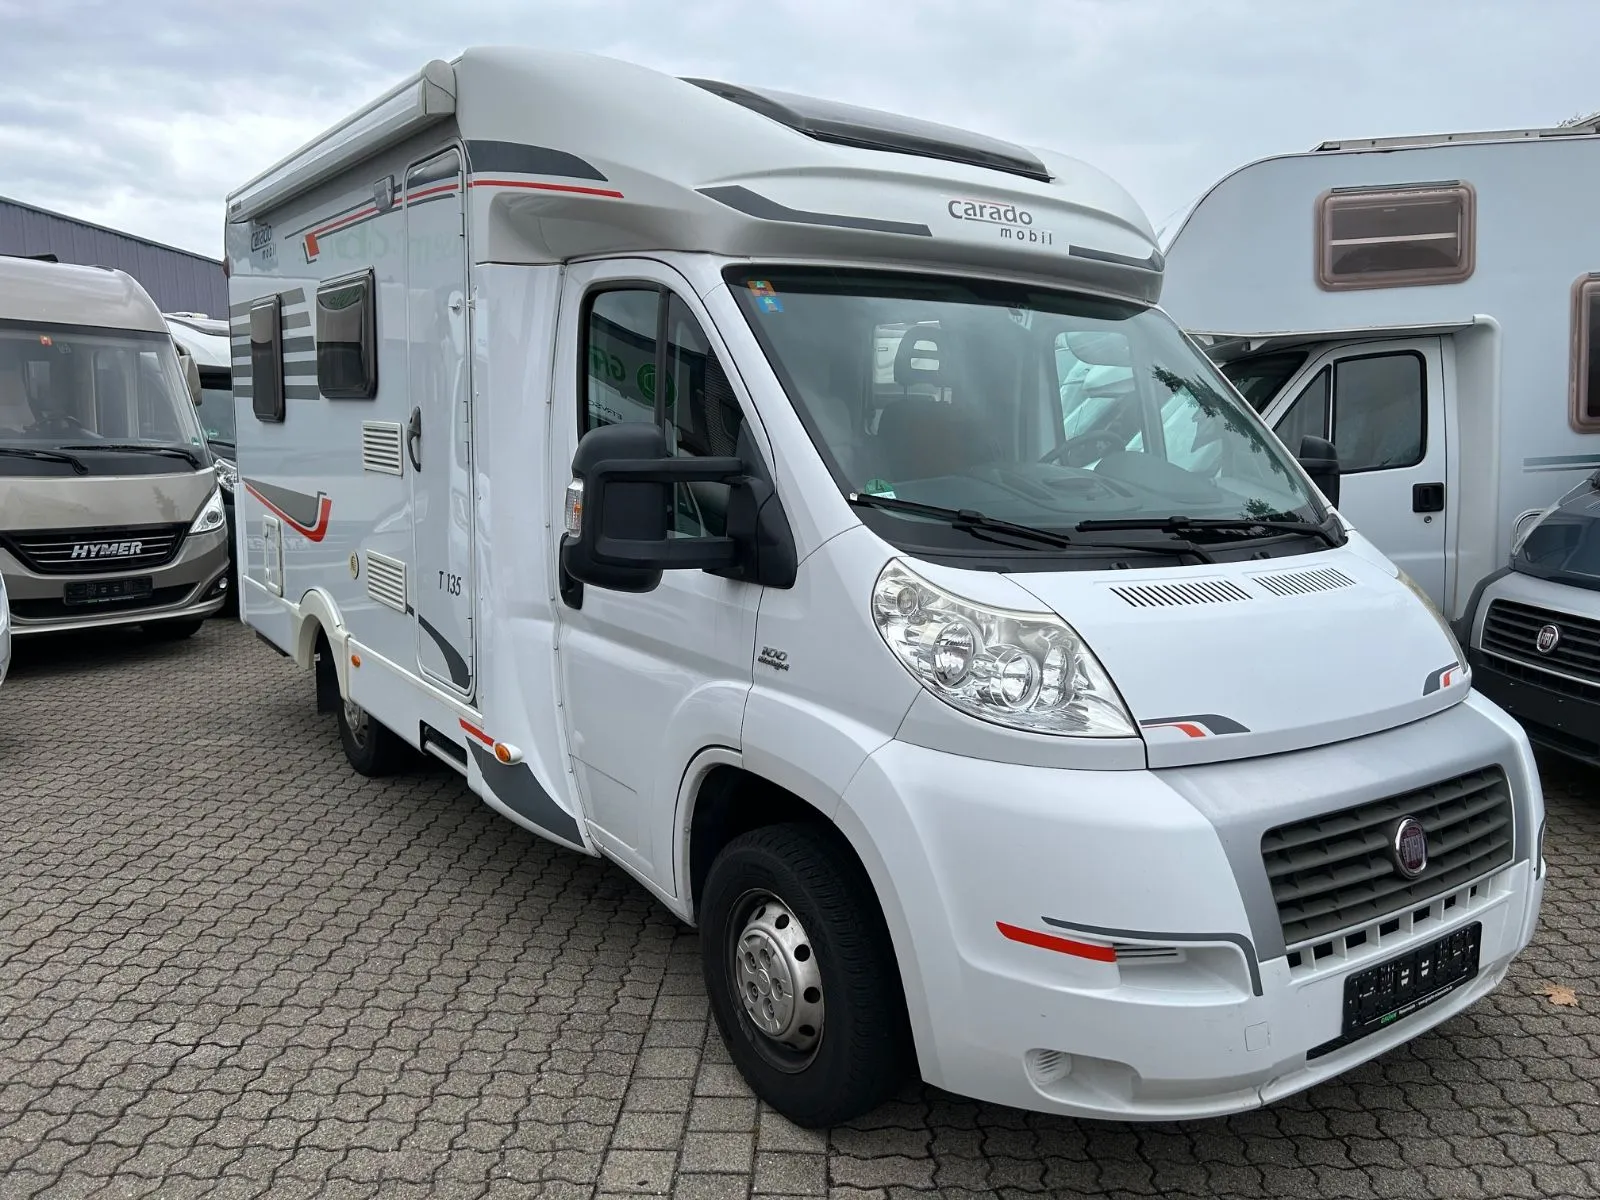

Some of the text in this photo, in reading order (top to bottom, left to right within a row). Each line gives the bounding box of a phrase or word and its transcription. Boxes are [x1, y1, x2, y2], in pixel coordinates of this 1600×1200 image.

[1000, 227, 1052, 245] mobil
[70, 541, 143, 558] HYMER
[438, 570, 462, 597] T 135
